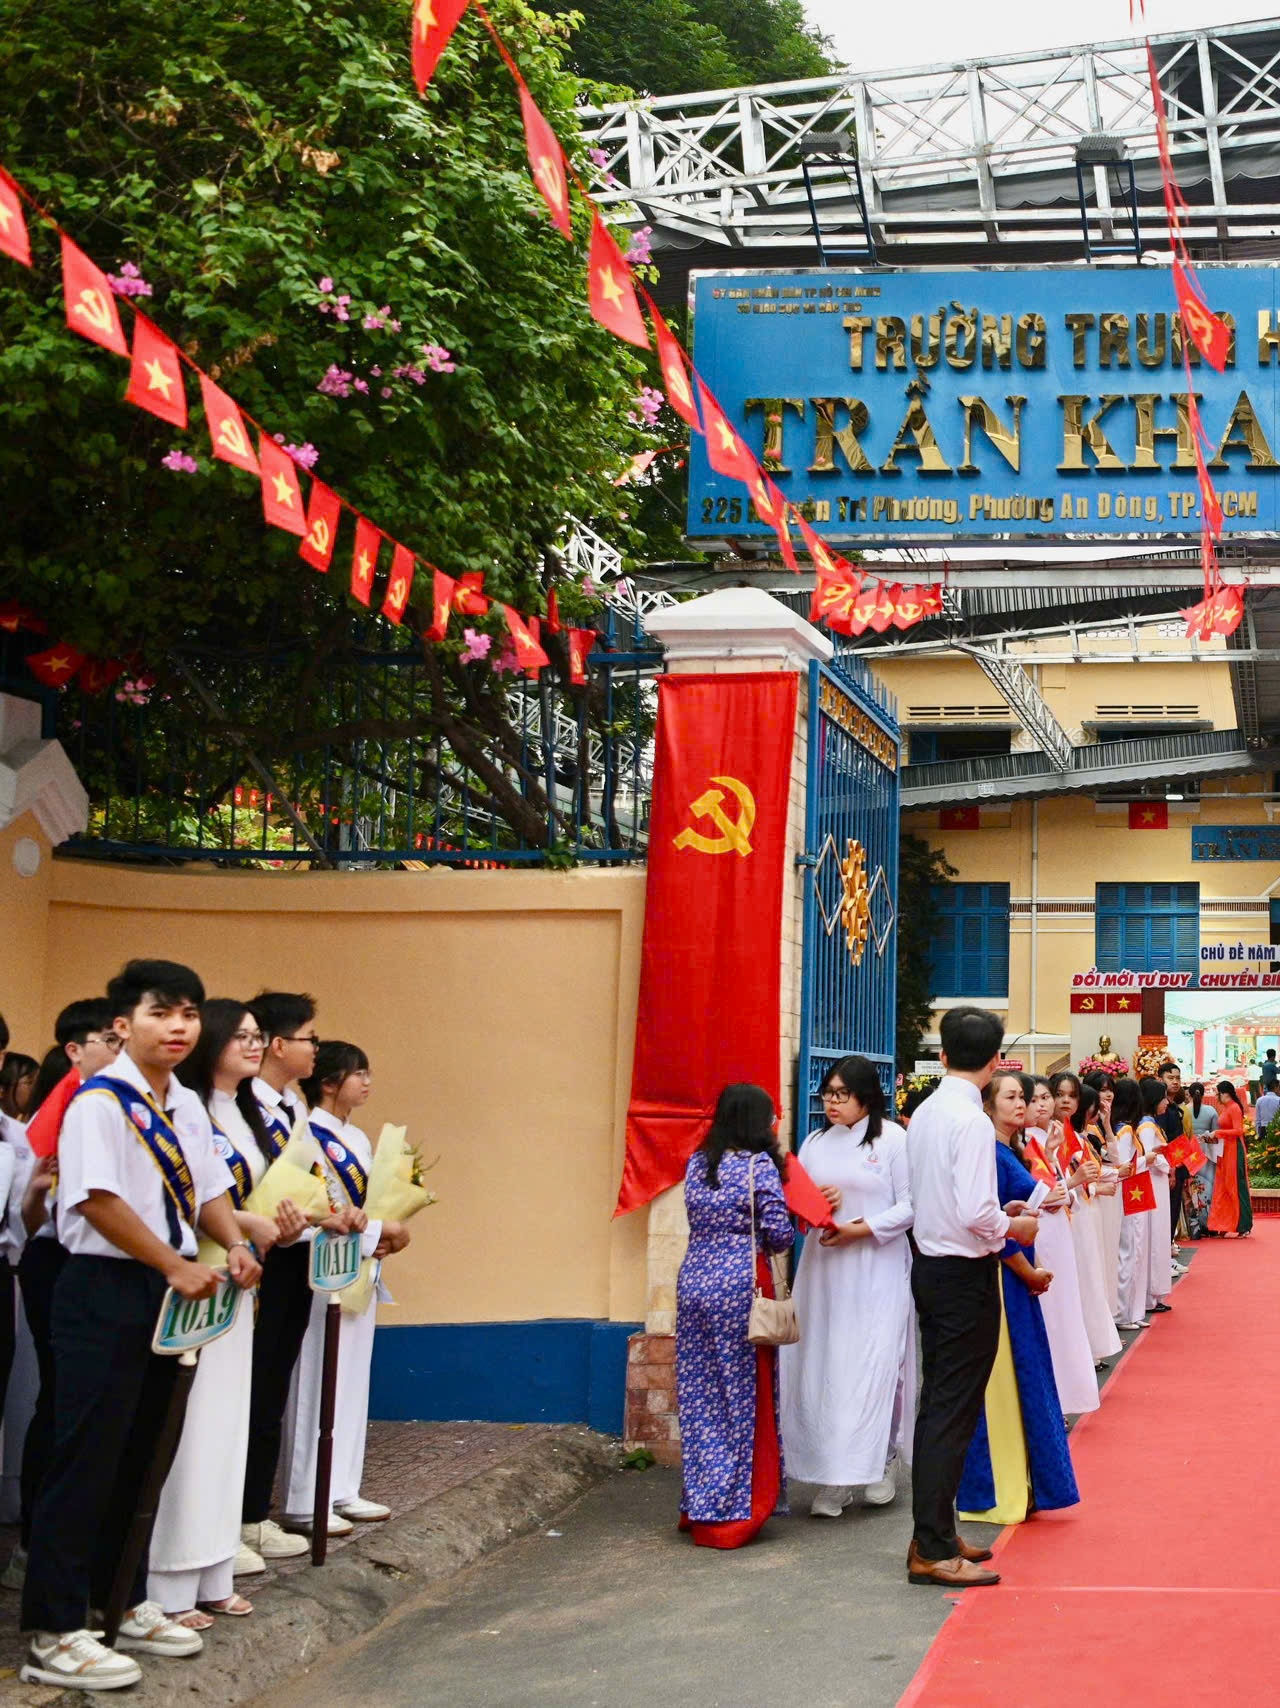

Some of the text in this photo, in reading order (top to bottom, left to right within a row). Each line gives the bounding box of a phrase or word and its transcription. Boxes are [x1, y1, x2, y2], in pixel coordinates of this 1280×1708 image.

[842, 300, 1047, 369] TRƯỜNG
[743, 368, 1027, 476] TRẦN
[701, 496, 742, 525] 225
[872, 494, 965, 525] Phương,
[968, 490, 1054, 523] Phường
[1060, 492, 1089, 519] An
[1097, 490, 1165, 524] Đông,
[1200, 942, 1225, 961] CHỦ
[1228, 941, 1245, 960] ĐỀ
[1248, 944, 1275, 961] NĂM
[1072, 967, 1101, 987] ĐỔI
[1103, 970, 1134, 986] MỚI
[1137, 972, 1158, 986] TƯ
[1158, 973, 1191, 986] DUY
[1199, 968, 1260, 987] CHUYỂN
[315, 1240, 358, 1279] 10A11
